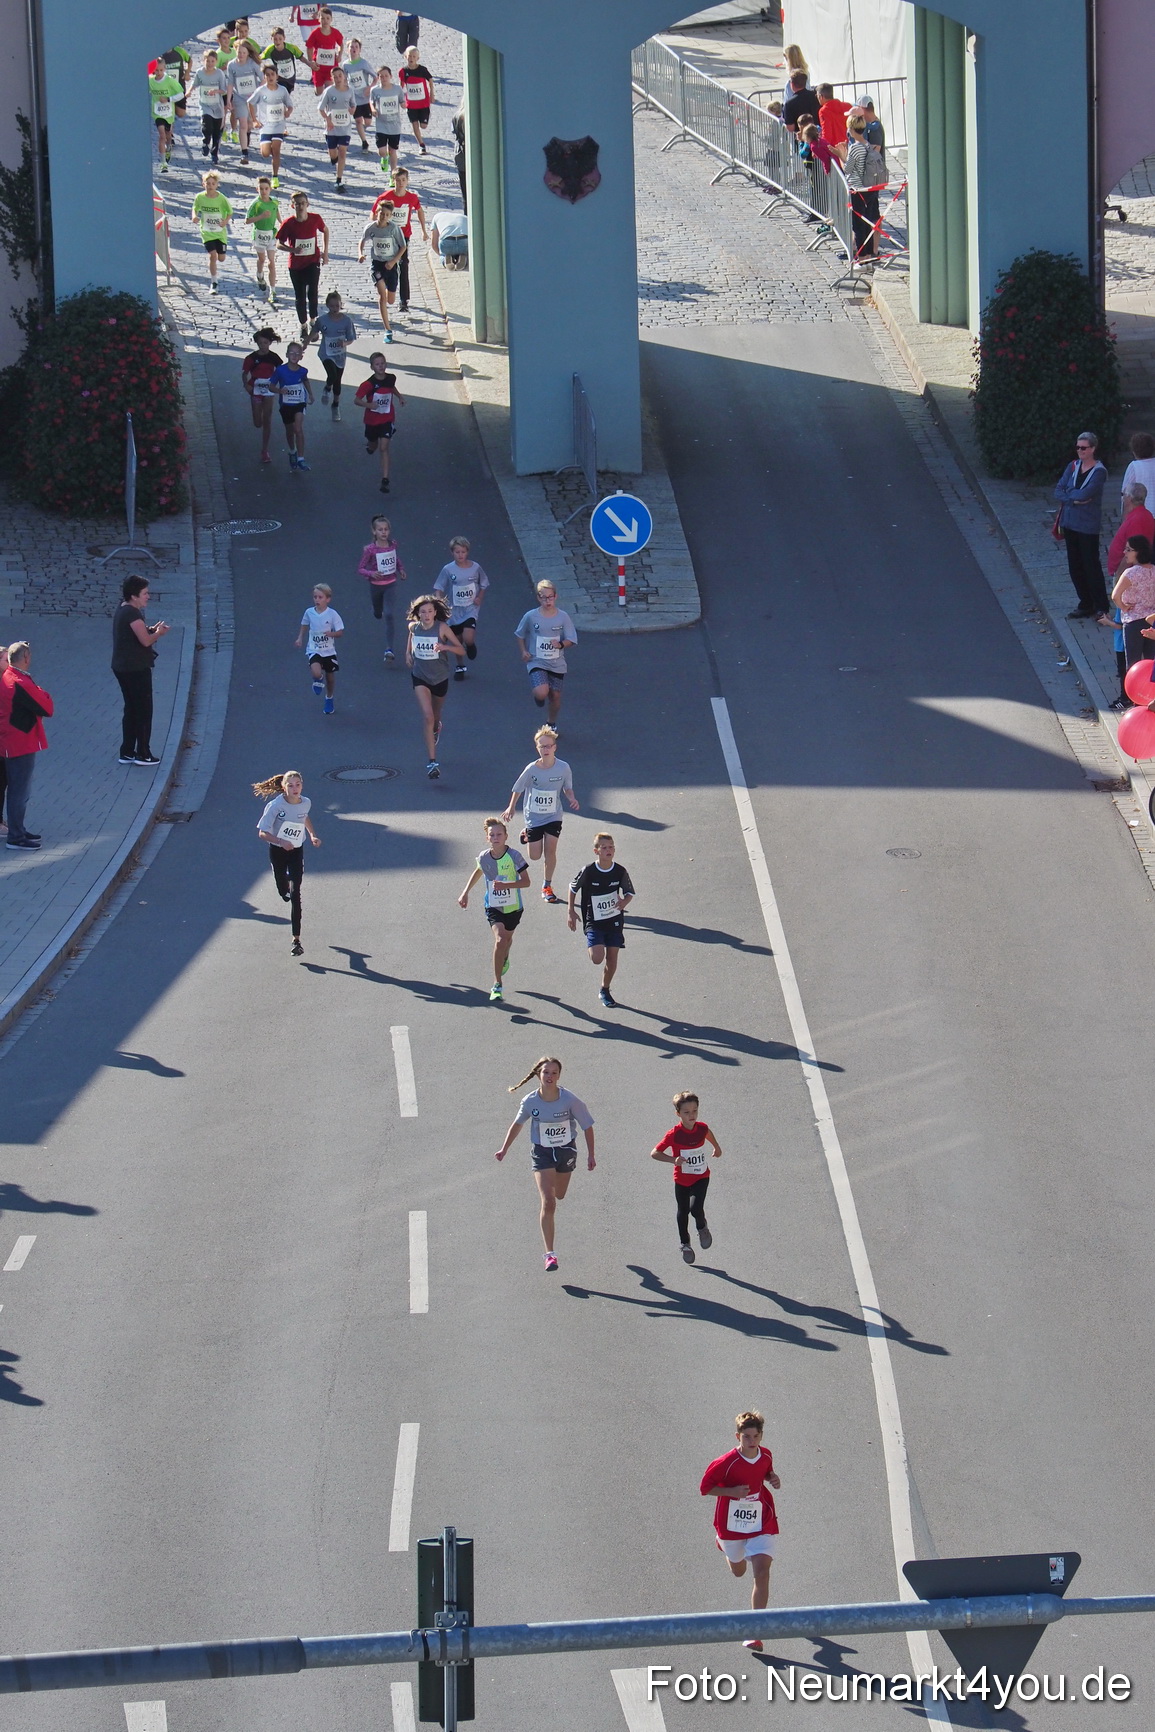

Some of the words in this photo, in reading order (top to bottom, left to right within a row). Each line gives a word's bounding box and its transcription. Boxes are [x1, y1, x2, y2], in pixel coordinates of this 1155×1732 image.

[456, 590, 473, 598] 4040
[416, 643, 434, 651] 4444
[534, 796, 553, 805] 4013
[283, 827, 301, 838] 4047
[492, 887, 511, 897] 4031
[597, 898, 616, 910] 4015
[545, 1127, 567, 1137] 4022
[733, 1509, 758, 1520] 4054
